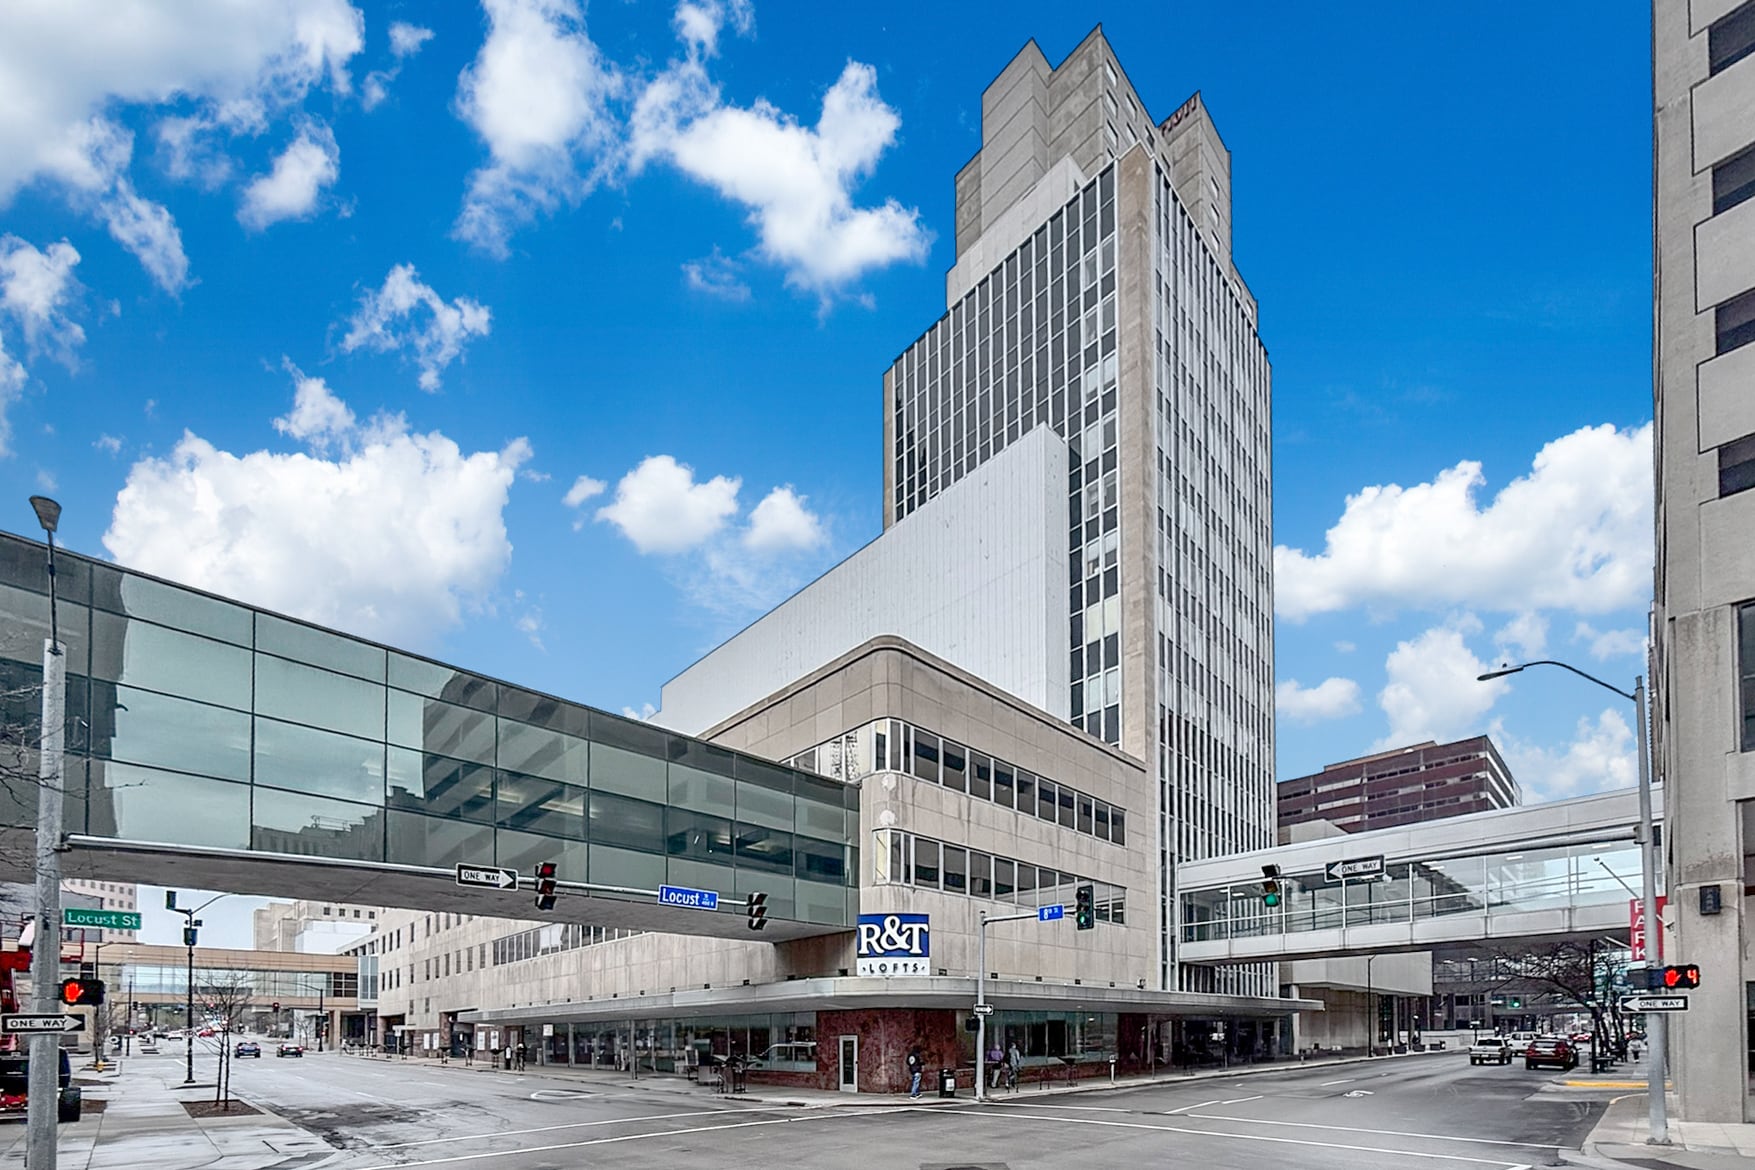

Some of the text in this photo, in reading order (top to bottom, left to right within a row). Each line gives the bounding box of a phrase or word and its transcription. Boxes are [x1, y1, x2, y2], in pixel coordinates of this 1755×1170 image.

[1342, 862, 1378, 873] ONE WAY
[463, 871, 480, 880] ONE
[662, 888, 700, 906] Locust
[67, 912, 137, 926] Locust St
[858, 915, 929, 954] R&T
[869, 963, 918, 974] LOFTS
[1687, 969, 1697, 984] 4
[10, 1019, 67, 1028] ONE WAY
